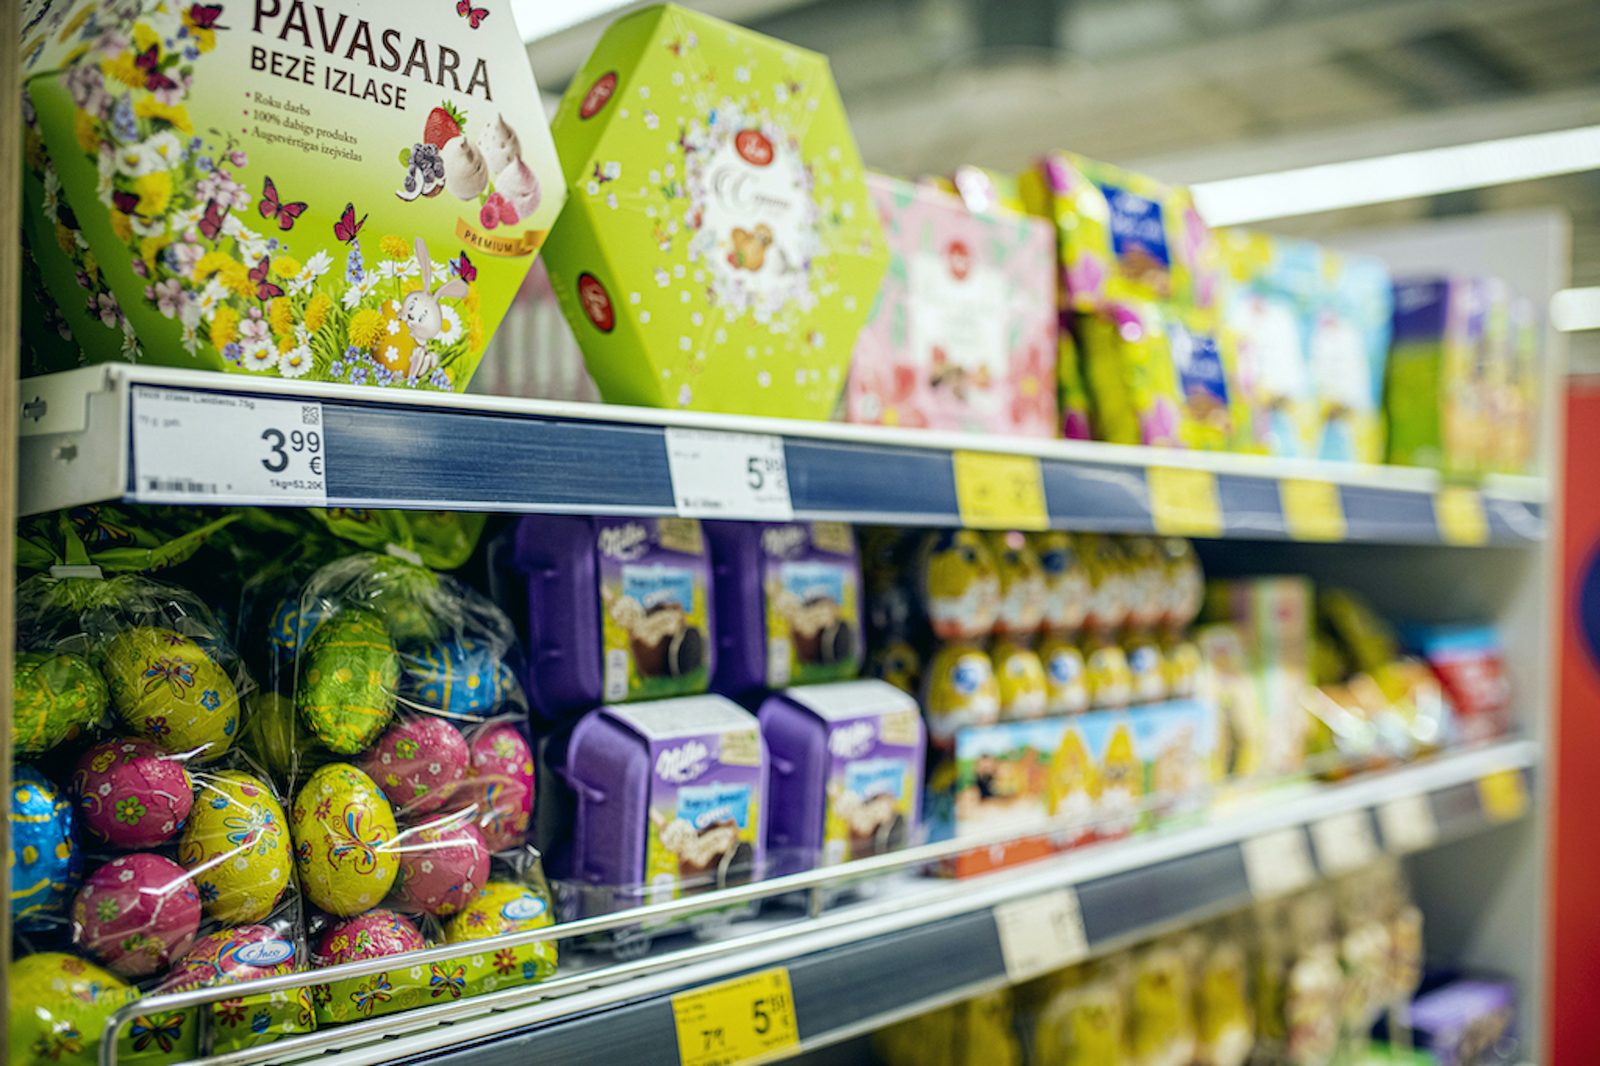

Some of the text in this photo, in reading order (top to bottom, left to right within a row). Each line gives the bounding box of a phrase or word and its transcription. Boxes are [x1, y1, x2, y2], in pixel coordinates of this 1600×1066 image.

[252, 0, 493, 102] PAVASARA
[251, 46, 407, 110] BEZĒ IZLASE
[253, 91, 311, 116] Roku darbs
[253, 109, 281, 126] 100%
[315, 127, 358, 145] produkts
[320, 144, 363, 162] izejvielas
[464, 229, 512, 252] PREMIUM
